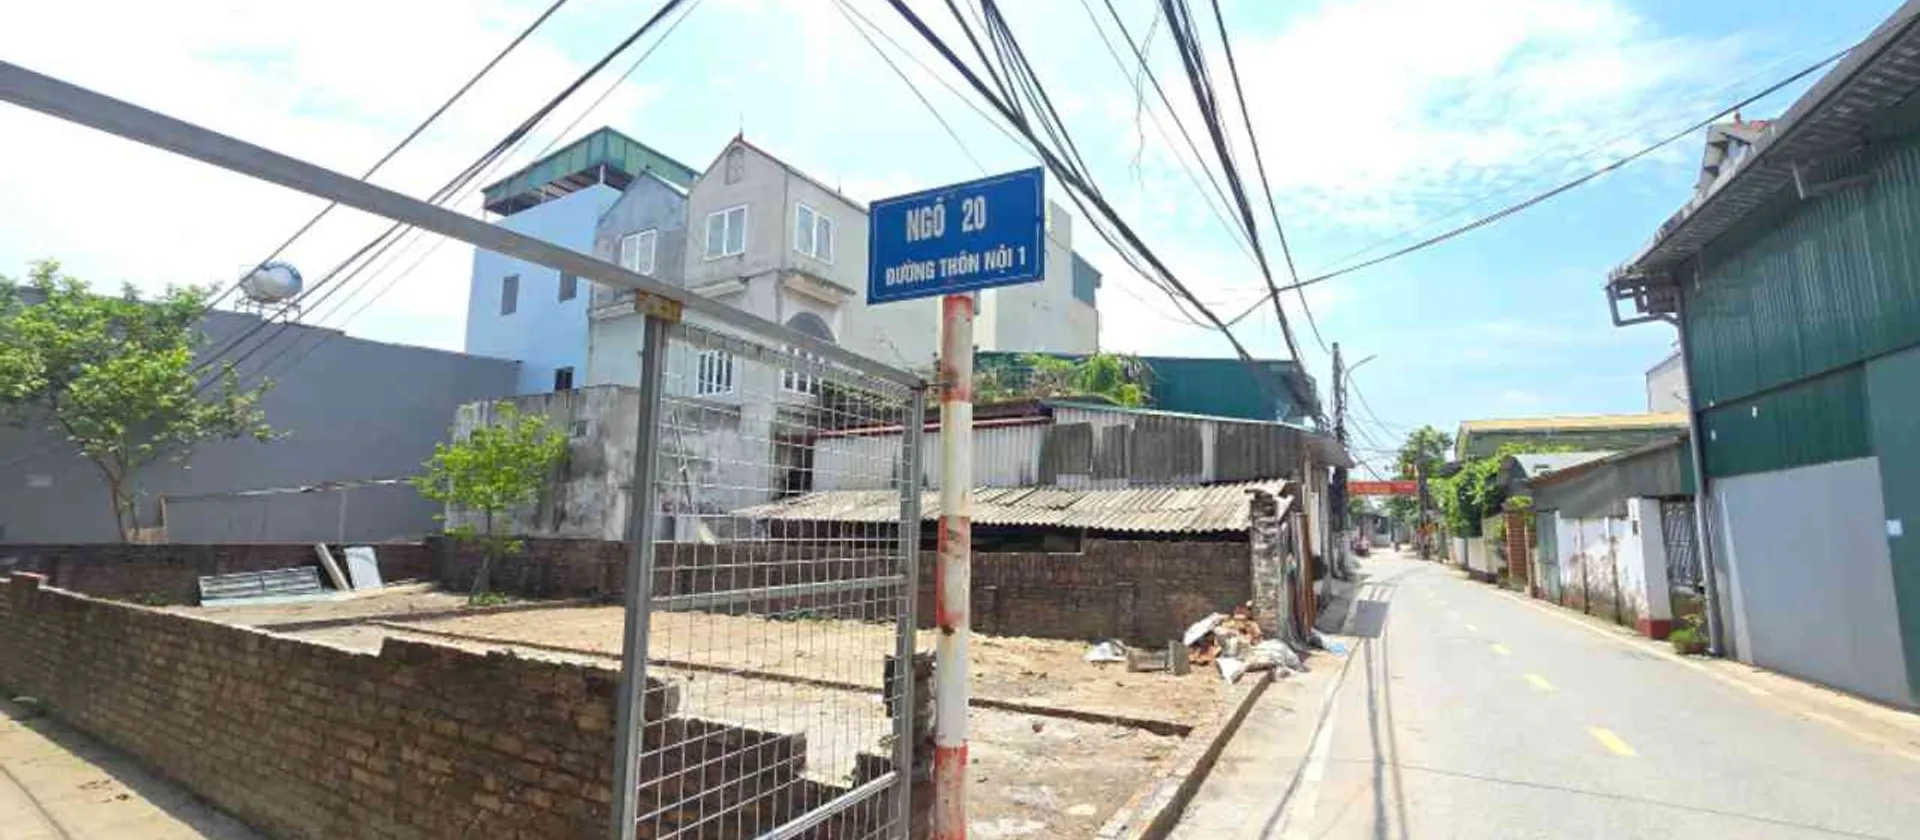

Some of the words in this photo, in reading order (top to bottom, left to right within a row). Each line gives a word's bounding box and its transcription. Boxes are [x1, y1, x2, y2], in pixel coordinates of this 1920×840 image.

[962, 195, 985, 232] 20
[886, 259, 935, 286] ĐƯỜNG
[939, 250, 979, 277] THÔN
[984, 244, 1013, 273] NỘI
[1018, 246, 1025, 265] 1
